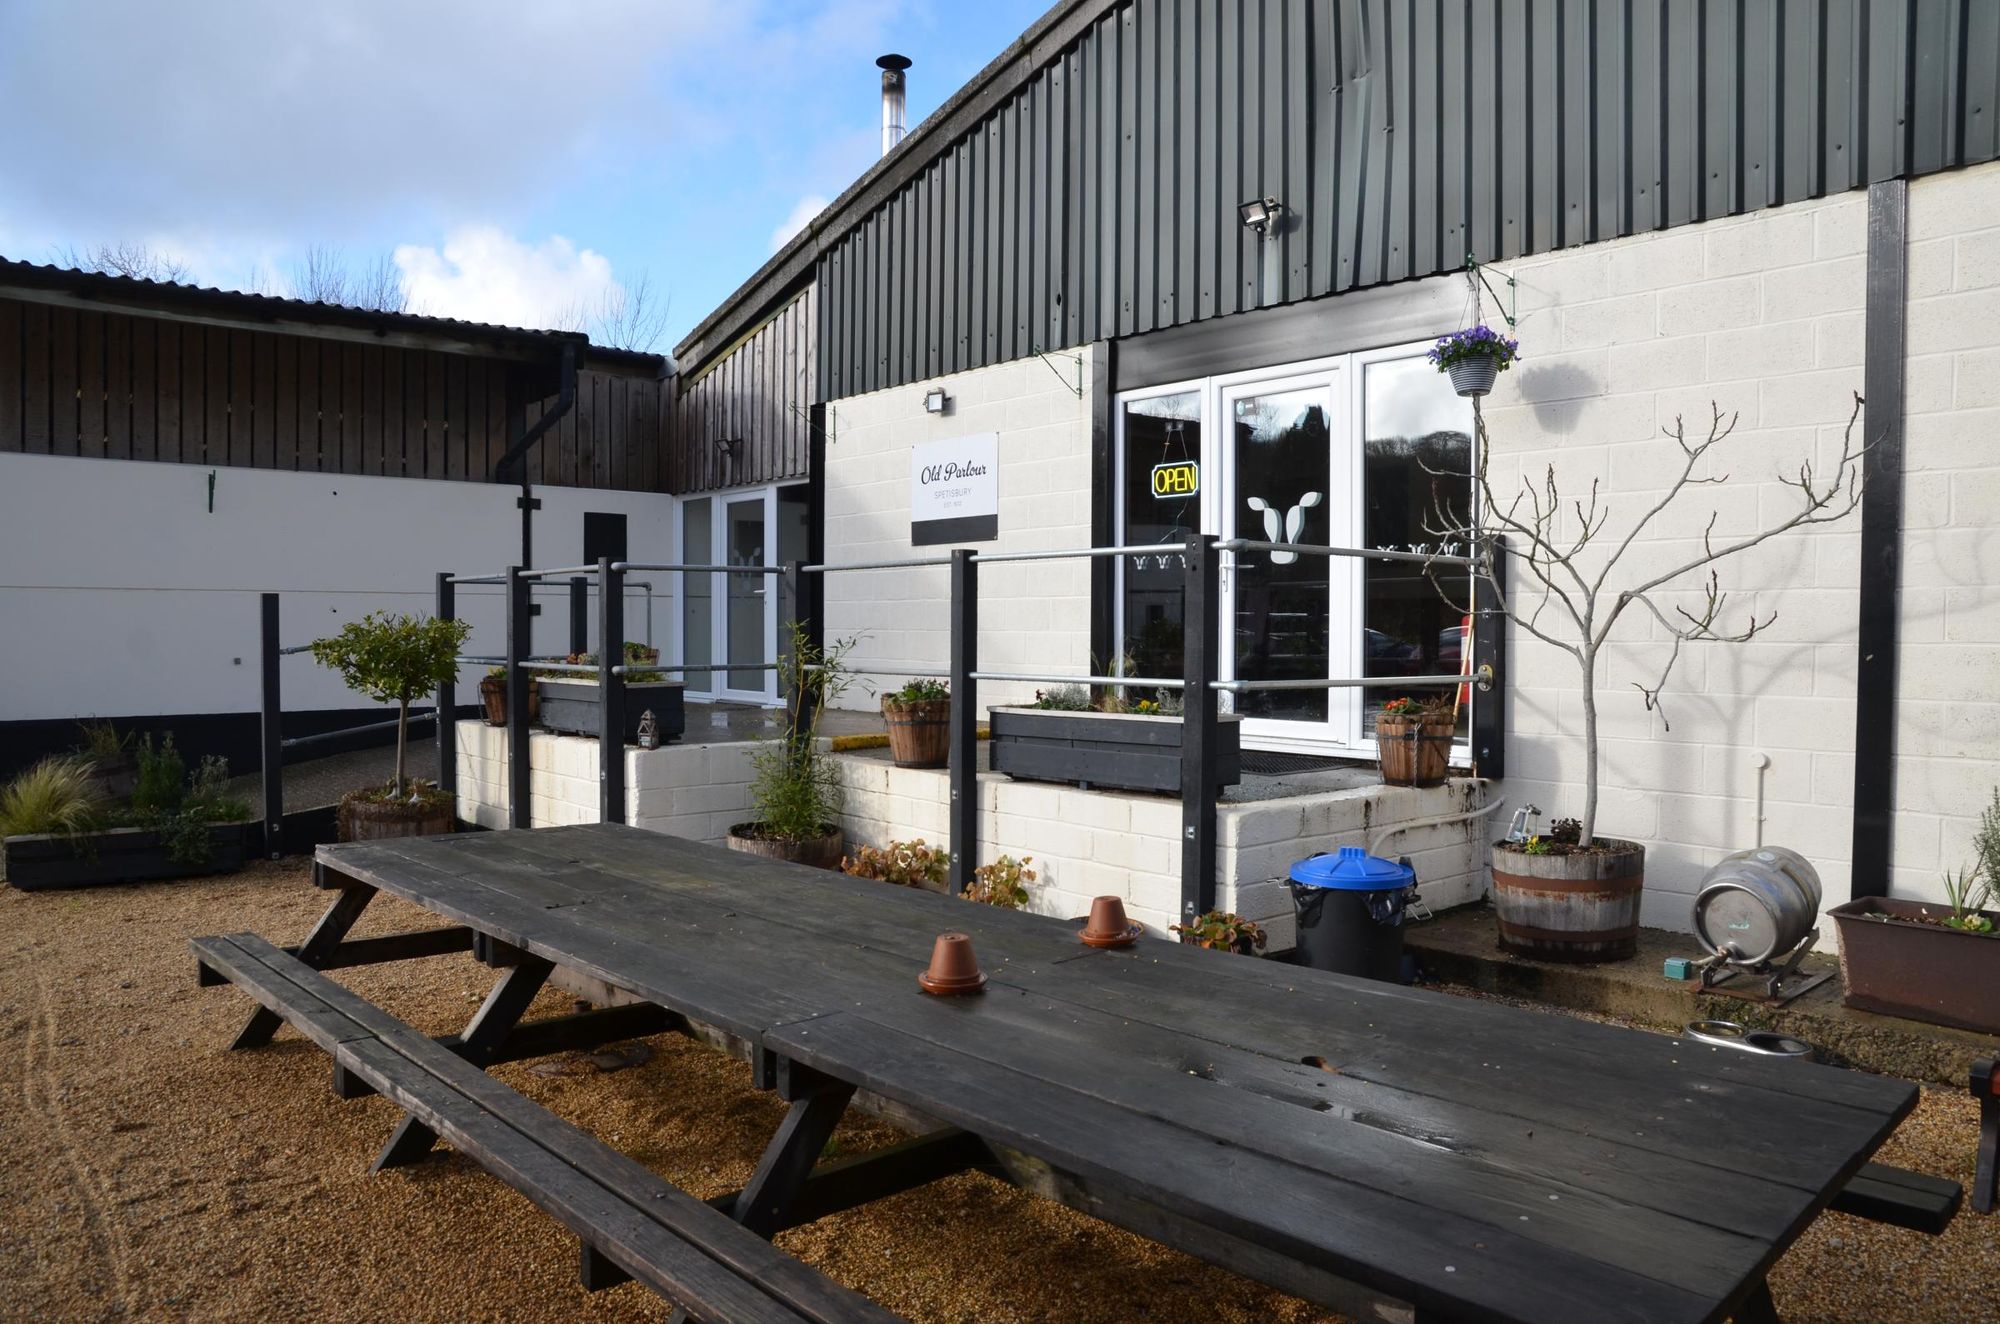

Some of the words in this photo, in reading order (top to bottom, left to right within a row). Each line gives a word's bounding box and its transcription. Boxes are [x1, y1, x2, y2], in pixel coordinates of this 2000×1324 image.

[921, 464, 942, 485] Old
[944, 460, 987, 481] Parlour
[1155, 466, 1195, 493] OPEN
[934, 487, 972, 499] SPETISBURY
